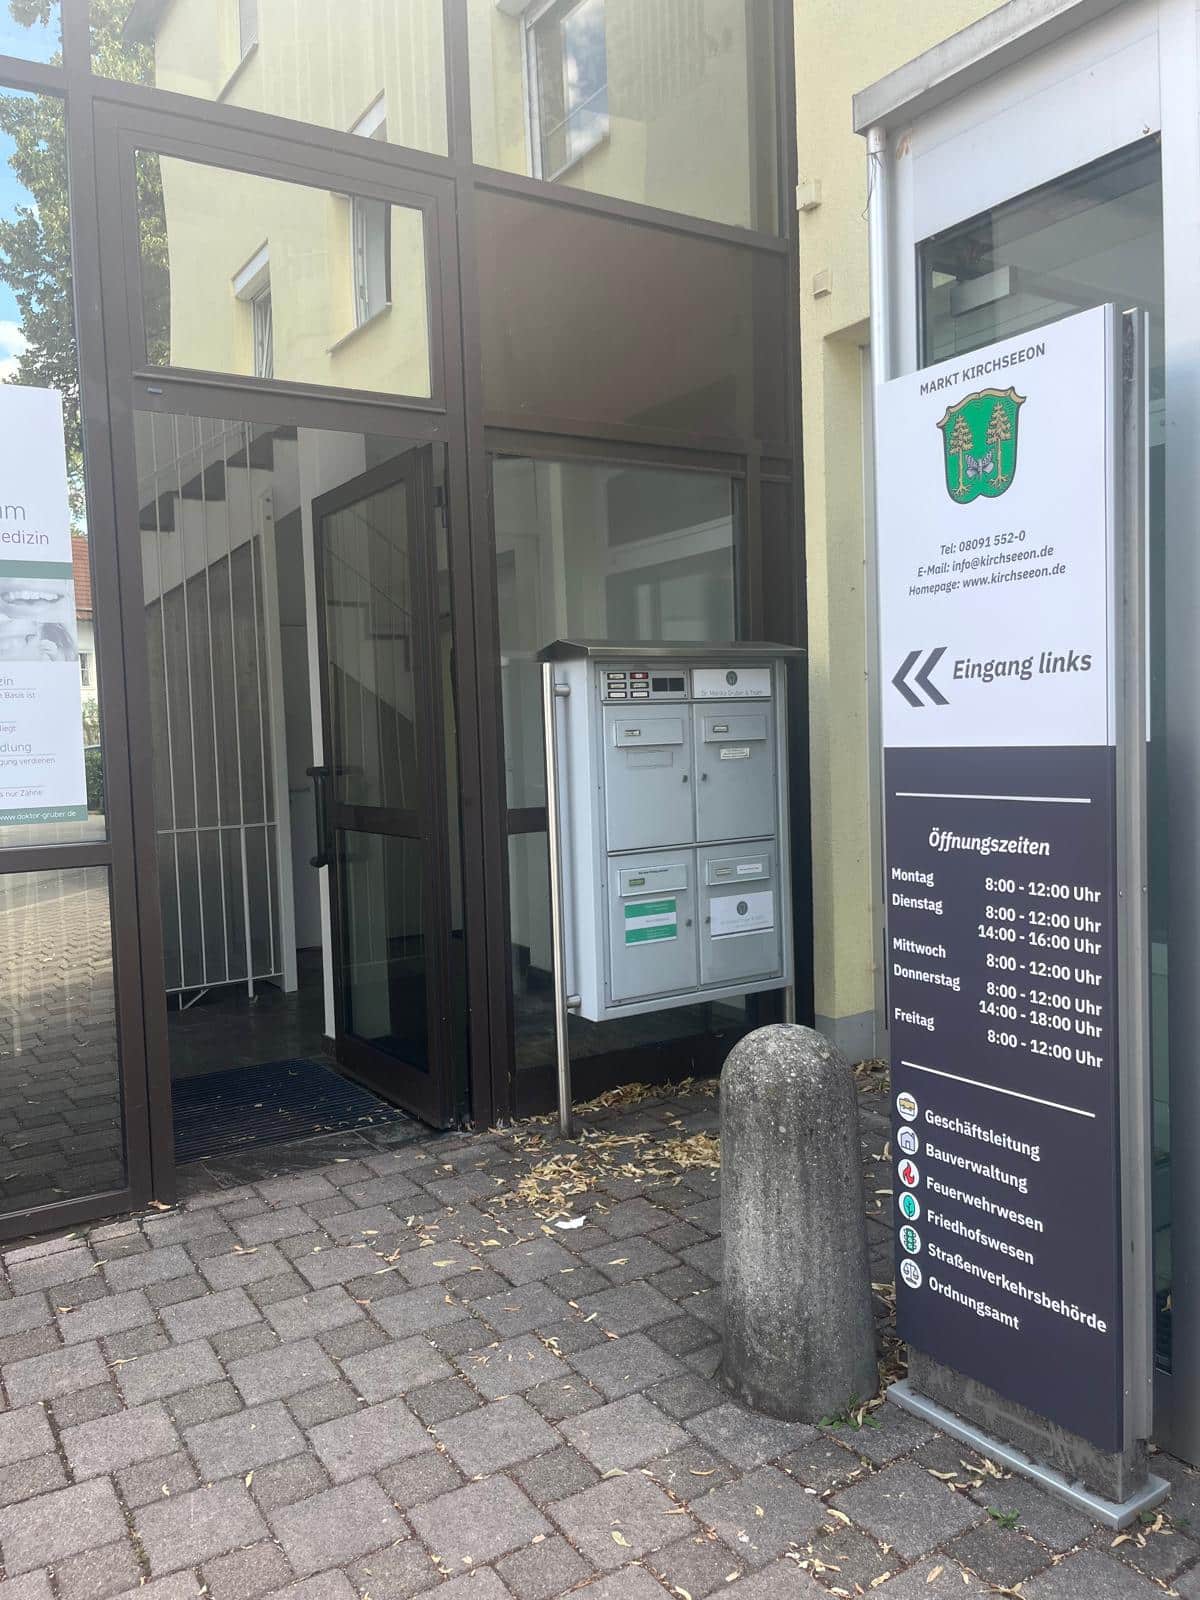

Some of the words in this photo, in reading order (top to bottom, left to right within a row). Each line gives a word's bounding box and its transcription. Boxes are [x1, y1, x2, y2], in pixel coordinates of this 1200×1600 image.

[920, 372, 960, 395] MARKT
[962, 342, 1045, 382] KIRCHSEEON
[0, 505, 26, 520] m
[0, 530, 49, 544] edizin
[940, 543, 956, 556] Tel:
[959, 536, 991, 552] 08091
[994, 530, 1026, 546] 552-0
[909, 582, 960, 596] Homepage:
[963, 563, 1066, 588] www.kirchseeon.de
[918, 562, 950, 577] E-Mail:
[952, 545, 1054, 572] info@kirchseeon.de
[953, 656, 1034, 683] Eingang
[1039, 650, 1092, 674] links
[0, 742, 32, 753] dlung
[928, 827, 1050, 856] Öffnungszeiten
[892, 868, 934, 887] Montag
[985, 878, 1015, 893] 8:00
[1028, 882, 1070, 899] 12:00
[1073, 886, 1101, 902] Uhr
[892, 894, 943, 915] Dienstag
[986, 906, 1016, 921] 8:00
[1028, 911, 1070, 928] 12:00
[1074, 916, 1101, 933] Uhr
[978, 925, 1016, 942] 14:00
[1029, 933, 1070, 950] 16:00
[1074, 938, 1101, 955] Uhr
[893, 938, 946, 958] Mittwoch
[986, 954, 1016, 970] 8:00
[1029, 962, 1070, 980] 12:00
[1074, 968, 1102, 986] Uhr
[893, 964, 960, 991] Donnerstag
[987, 982, 1016, 999] 8:00
[1030, 990, 1070, 1009] 12:00
[1075, 998, 1102, 1016] Uhr
[895, 1008, 935, 1031] Freitag
[987, 1030, 1017, 1047] 8:00
[1030, 1040, 1071, 1060] 12:00
[1076, 1050, 1103, 1068] Uhr
[979, 1000, 1016, 1019] 14:00
[1030, 1011, 1071, 1031] 18:00
[1075, 1020, 1102, 1038] Uhr
[925, 1110, 1040, 1162] Geschäftsleitung
[926, 1143, 1028, 1193] Bauverwaltung
[926, 1176, 1044, 1232] Feuerwehrwesen
[927, 1210, 1034, 1265] Friedhofswesen
[928, 1243, 1107, 1333] Straßenverkehrsbehörde
[929, 1276, 1019, 1330] Ordnungsamt
